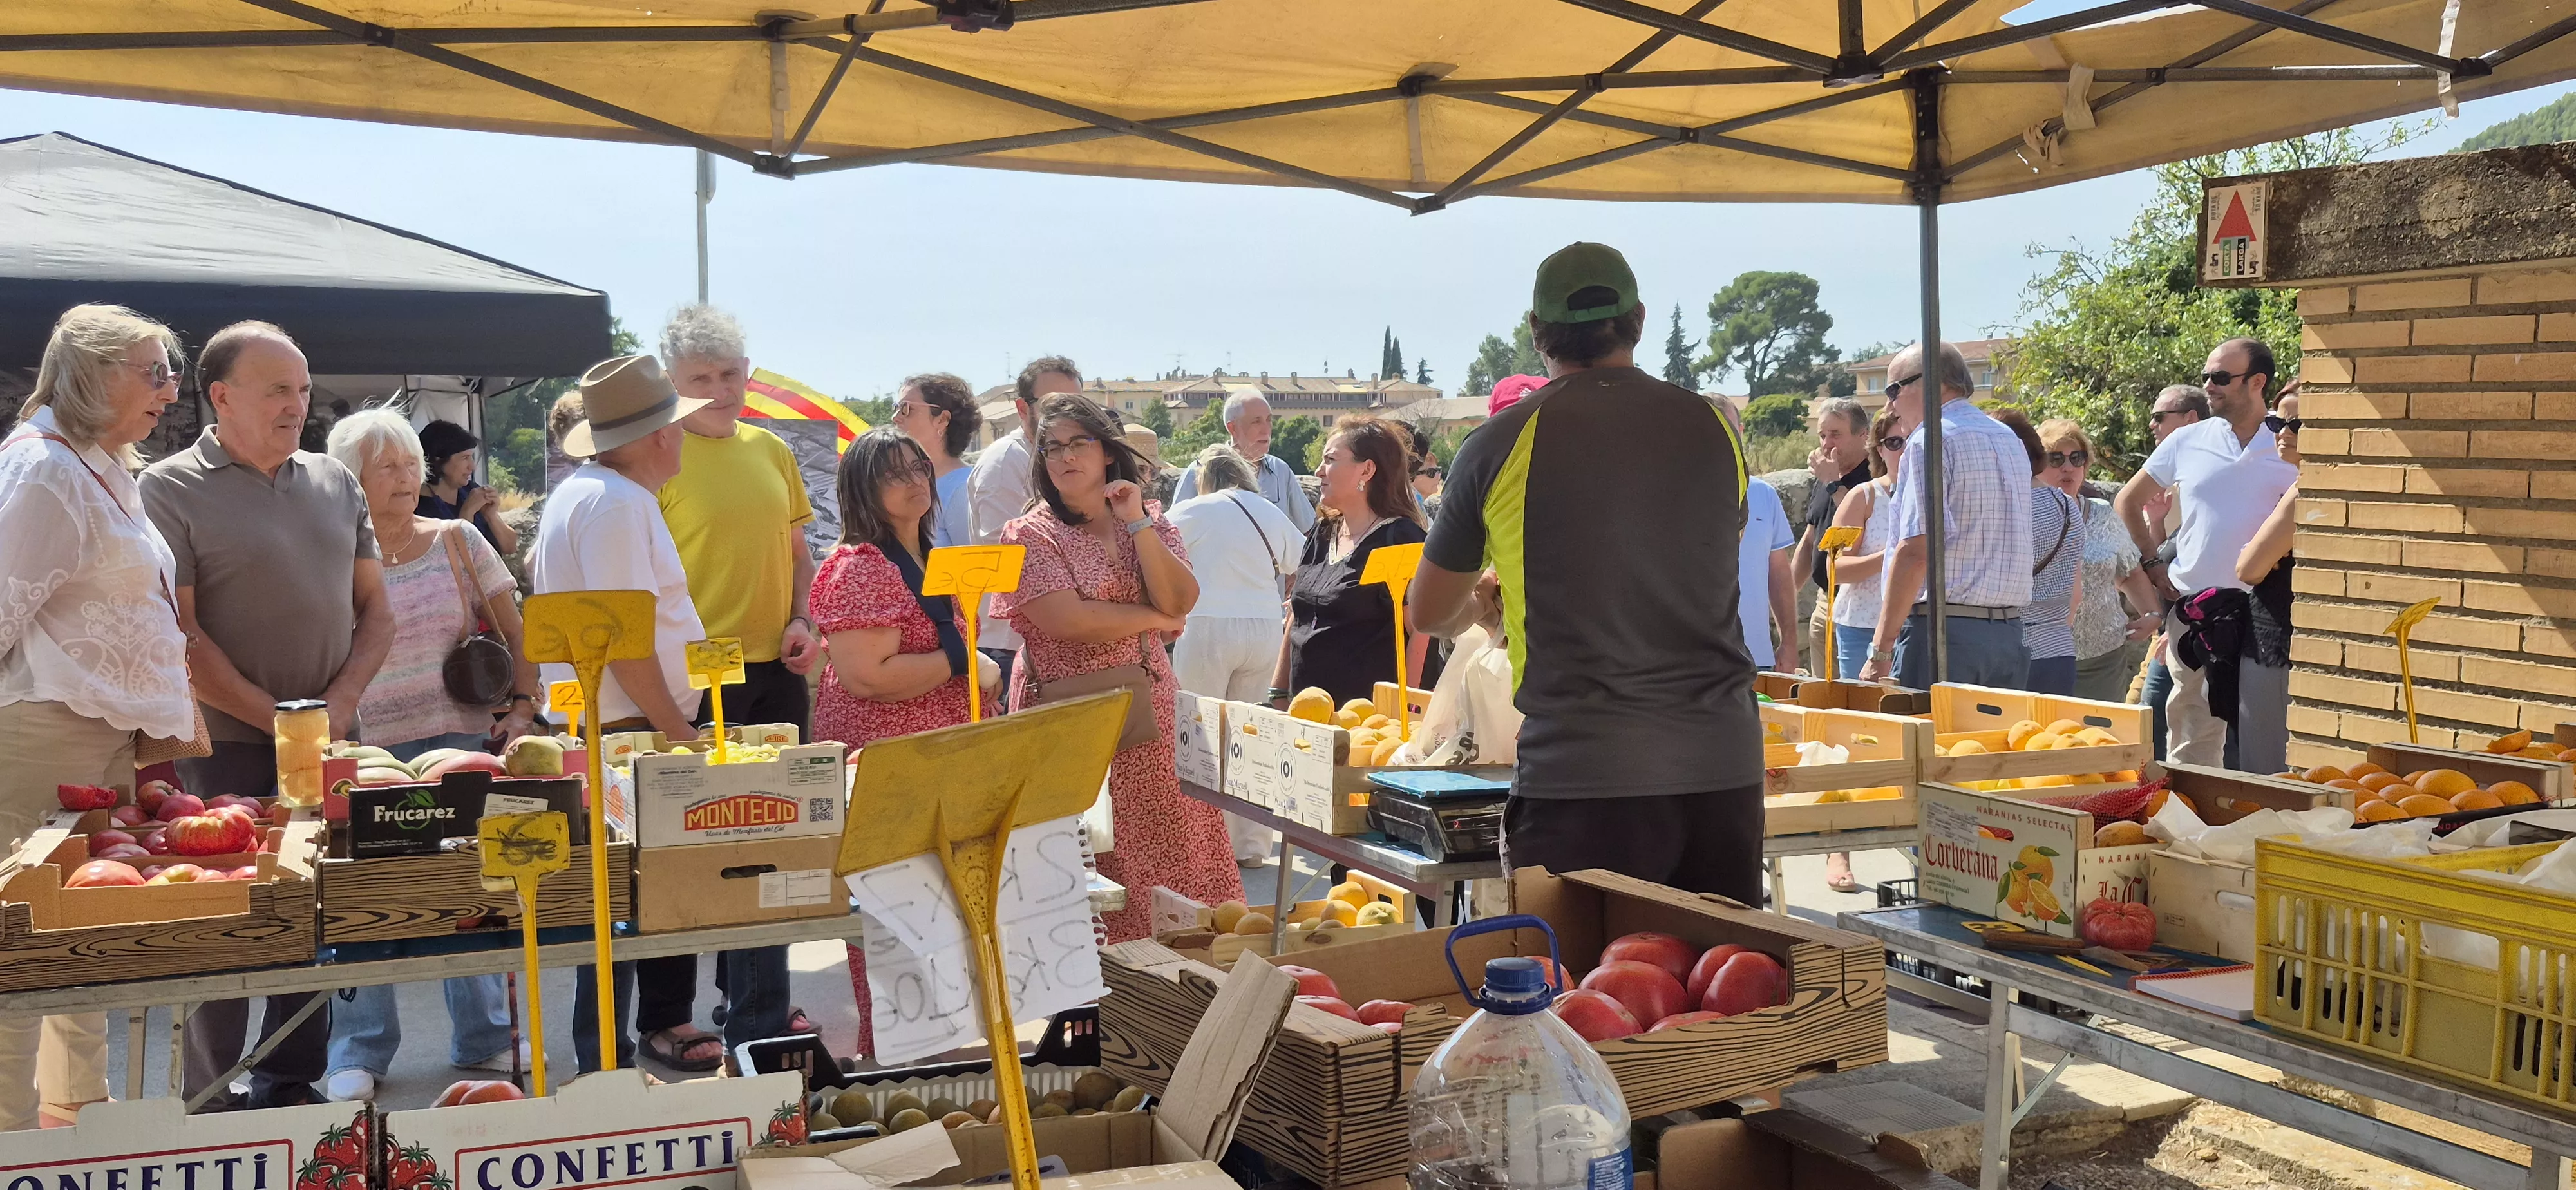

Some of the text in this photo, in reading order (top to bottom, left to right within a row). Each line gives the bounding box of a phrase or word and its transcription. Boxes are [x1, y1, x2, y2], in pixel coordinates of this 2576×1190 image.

[557, 685, 585, 706] 2
[374, 805, 456, 822] Frucarez
[687, 798, 795, 828] MONTECID
[1976, 806, 2072, 832] NARANJAS SELECTAS
[1925, 833, 1999, 882] Corberana
[2099, 853, 2146, 864] NARANJ
[7, 1153, 269, 1190] NFETTi
